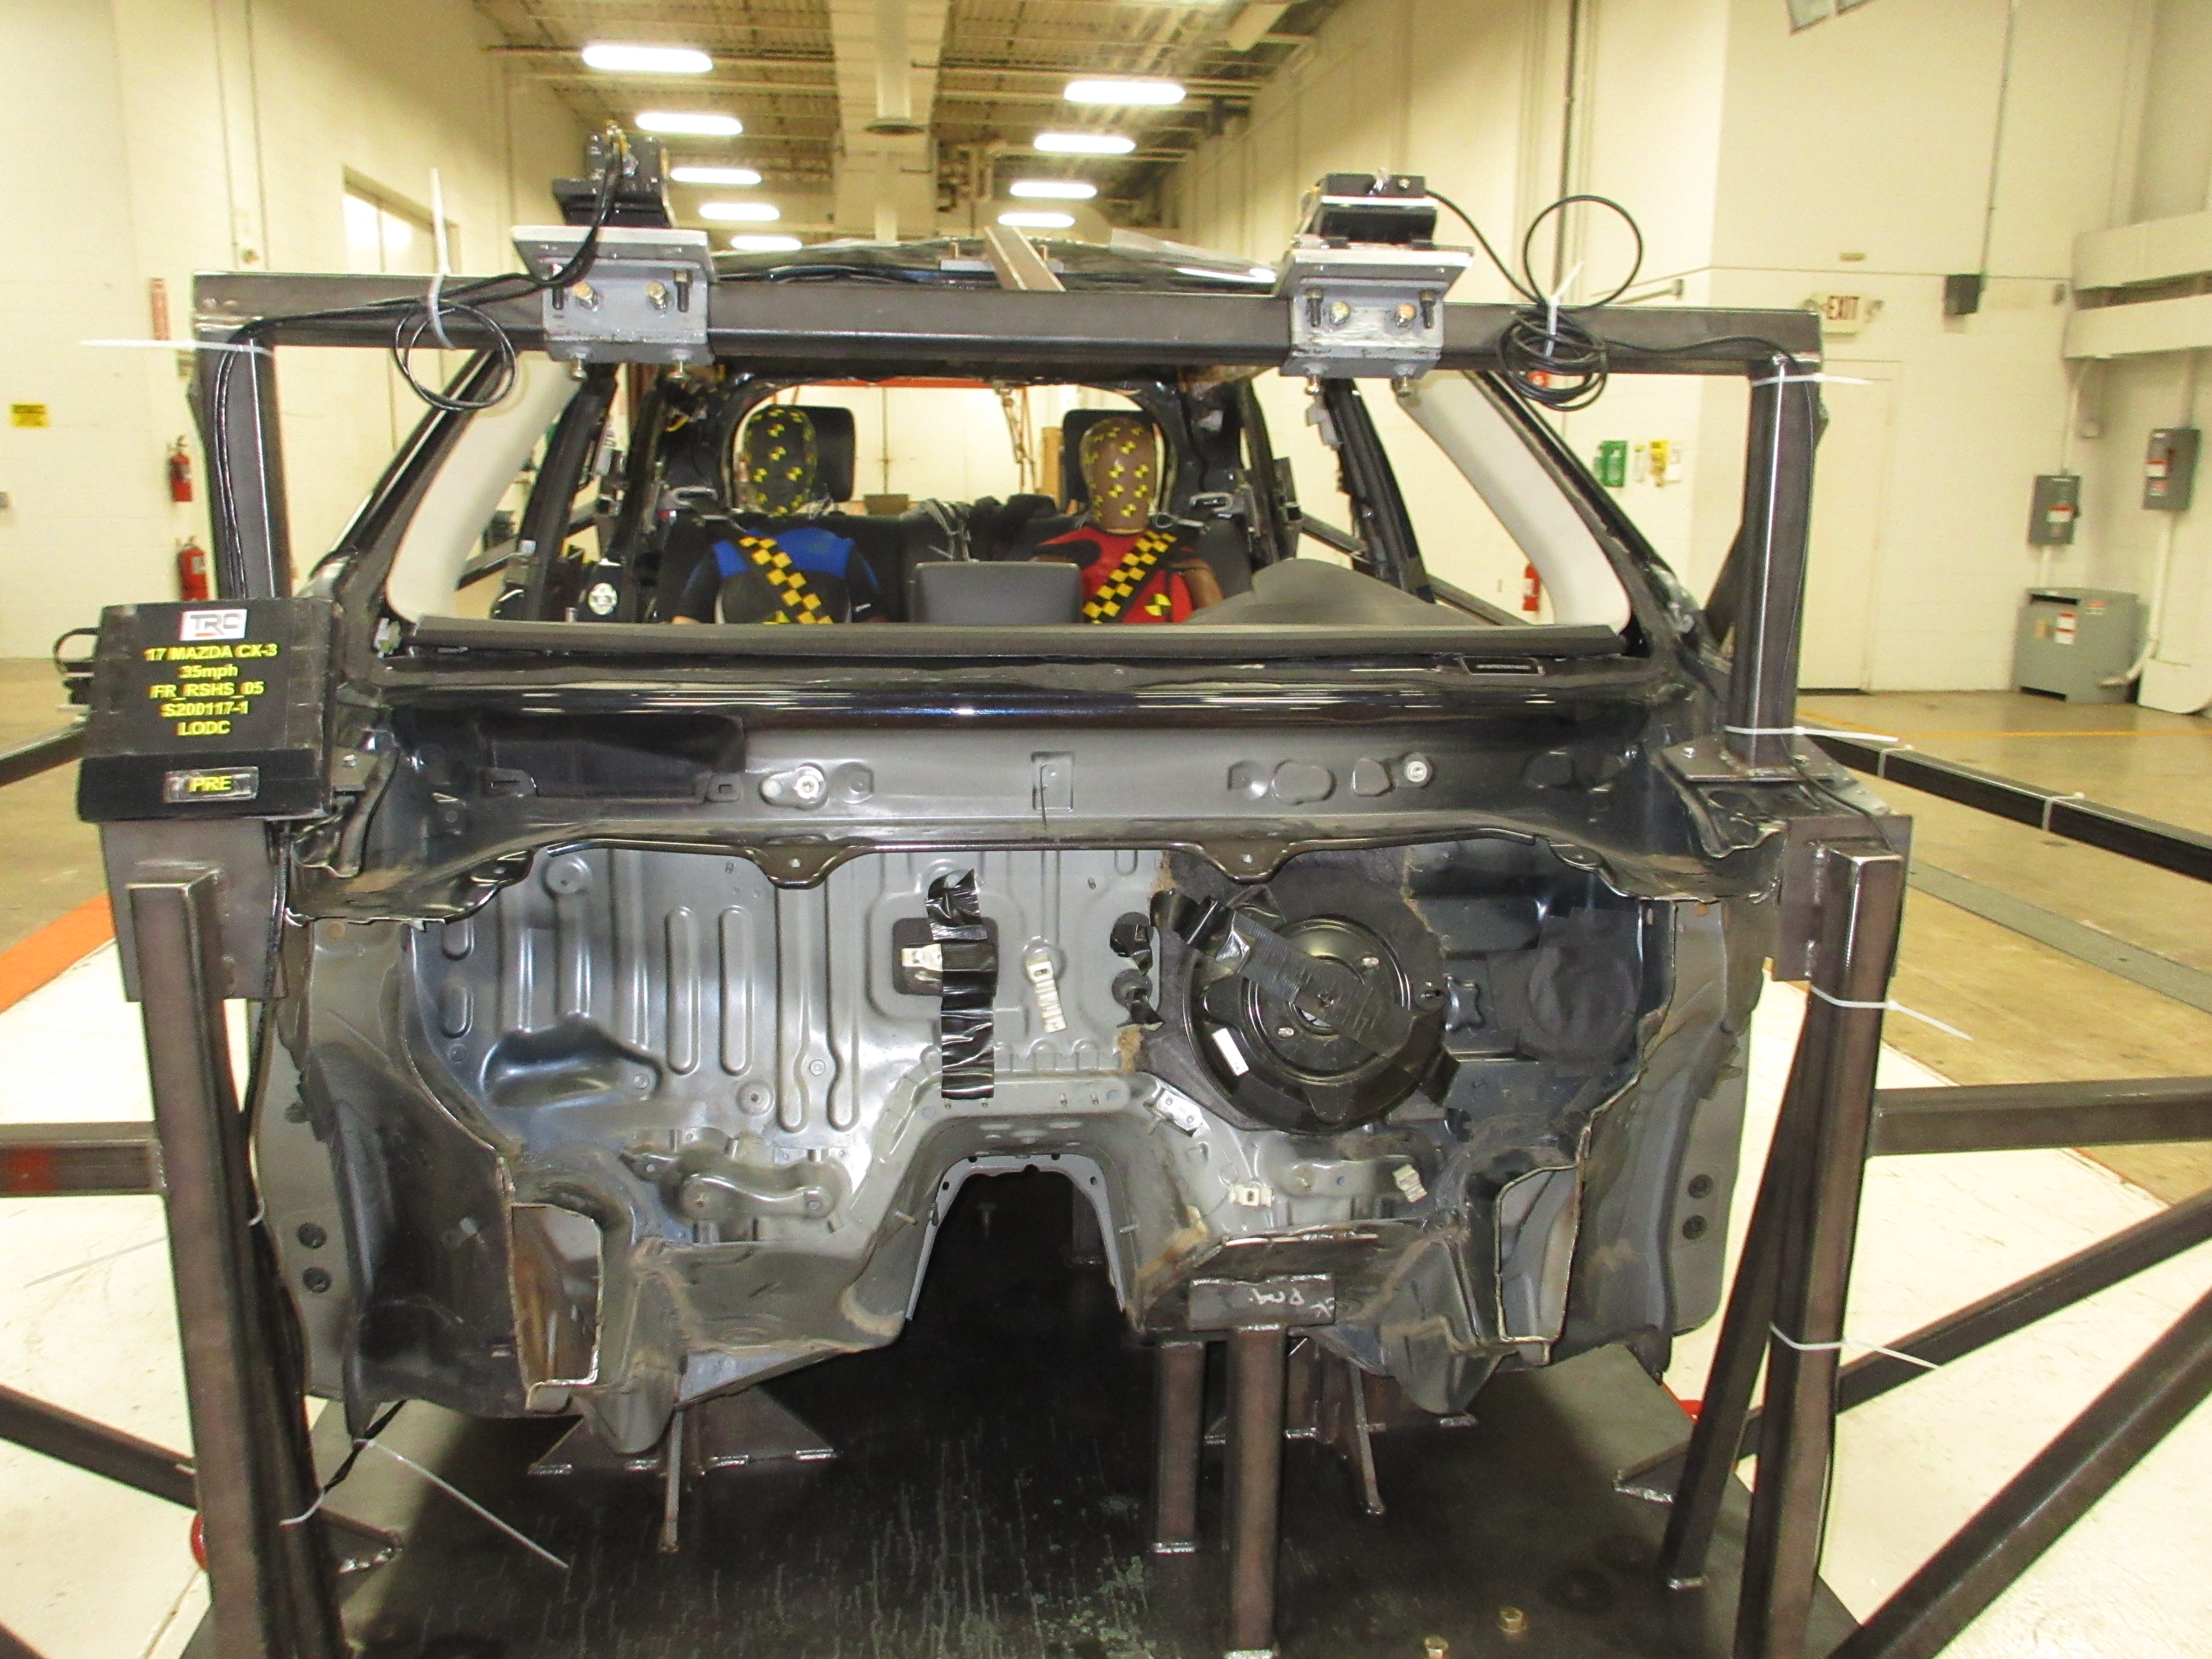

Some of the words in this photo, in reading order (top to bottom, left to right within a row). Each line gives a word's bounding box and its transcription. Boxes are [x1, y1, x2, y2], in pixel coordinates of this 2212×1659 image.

[190, 613, 240, 635] TRC
[143, 648, 167, 661] 17
[166, 645, 233, 660] MAZDA
[234, 643, 278, 658] CX-3
[177, 664, 239, 680] 35mph
[160, 701, 249, 717] S200117-1
[175, 720, 231, 736] LODC
[188, 776, 232, 792] PRE
